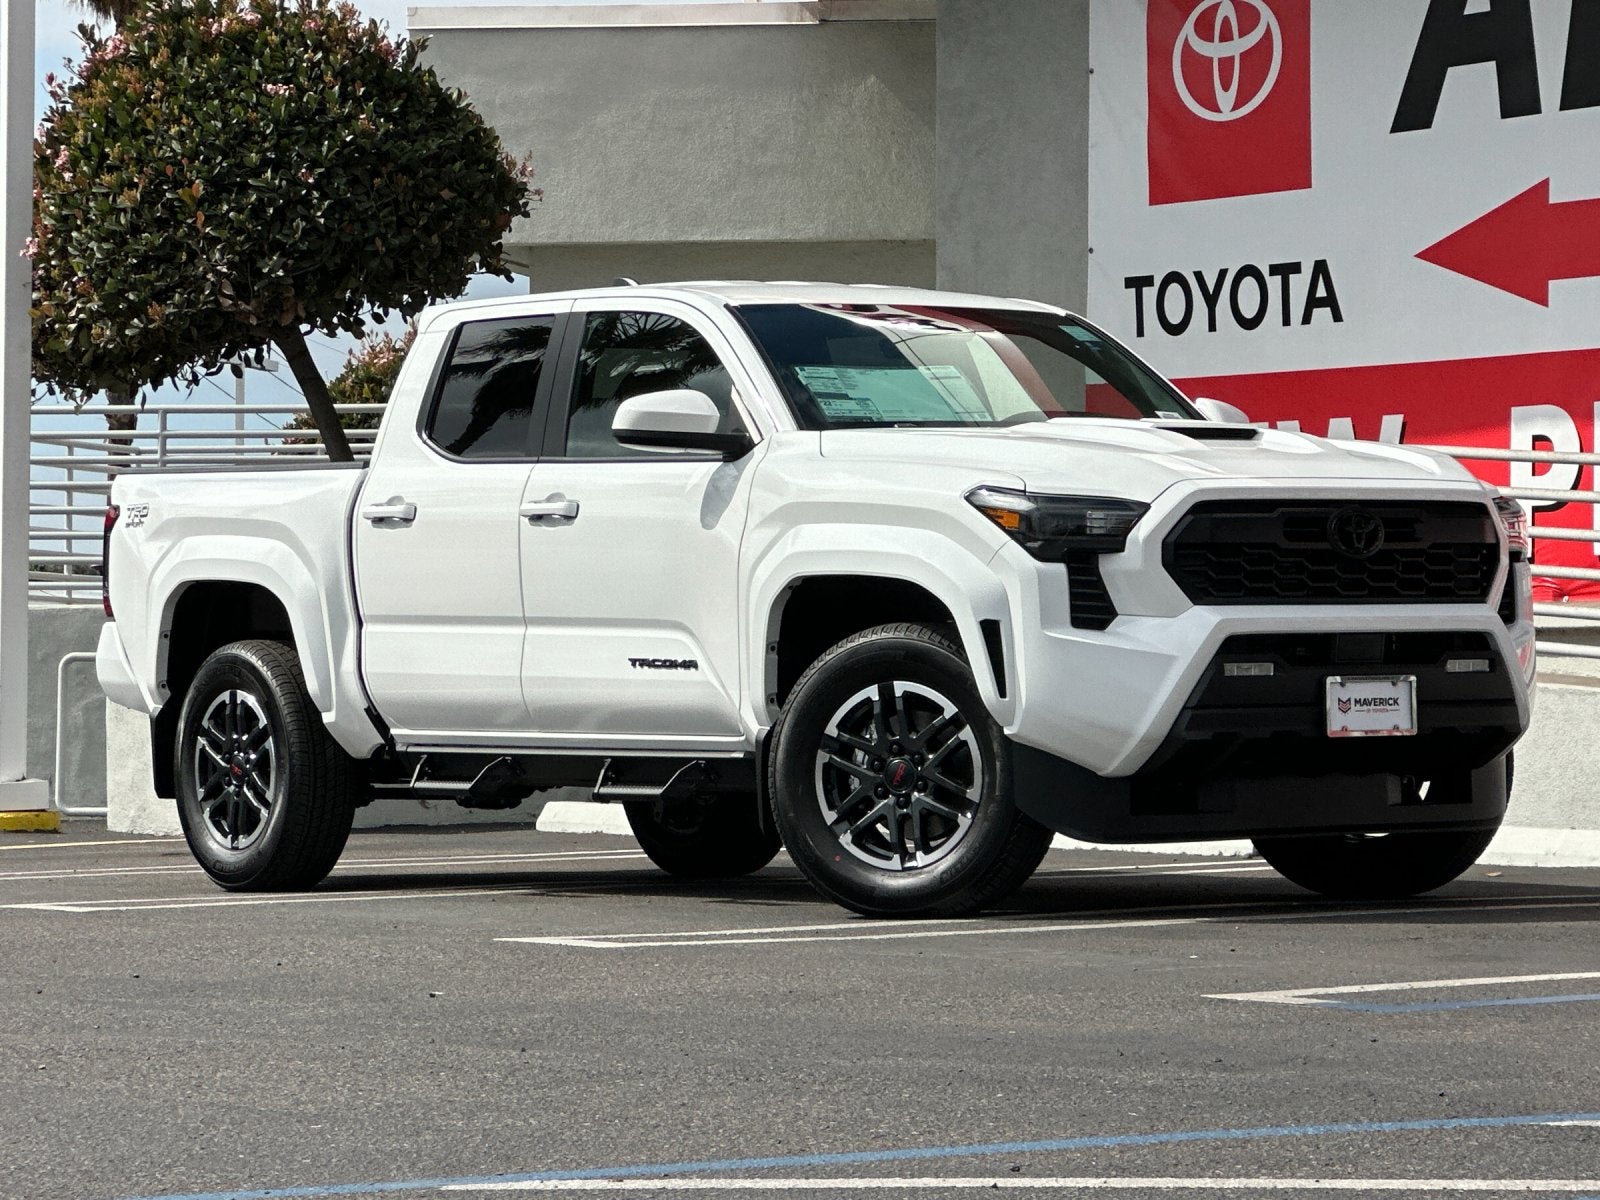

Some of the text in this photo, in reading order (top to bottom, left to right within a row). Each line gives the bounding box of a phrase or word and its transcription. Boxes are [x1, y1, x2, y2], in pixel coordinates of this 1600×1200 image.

[1389, 0, 1600, 134] A
[1124, 259, 1344, 338] TOYOTA
[127, 503, 149, 519] TRD
[628, 658, 698, 670] TACOMA
[1354, 697, 1400, 707] MAVERICK
